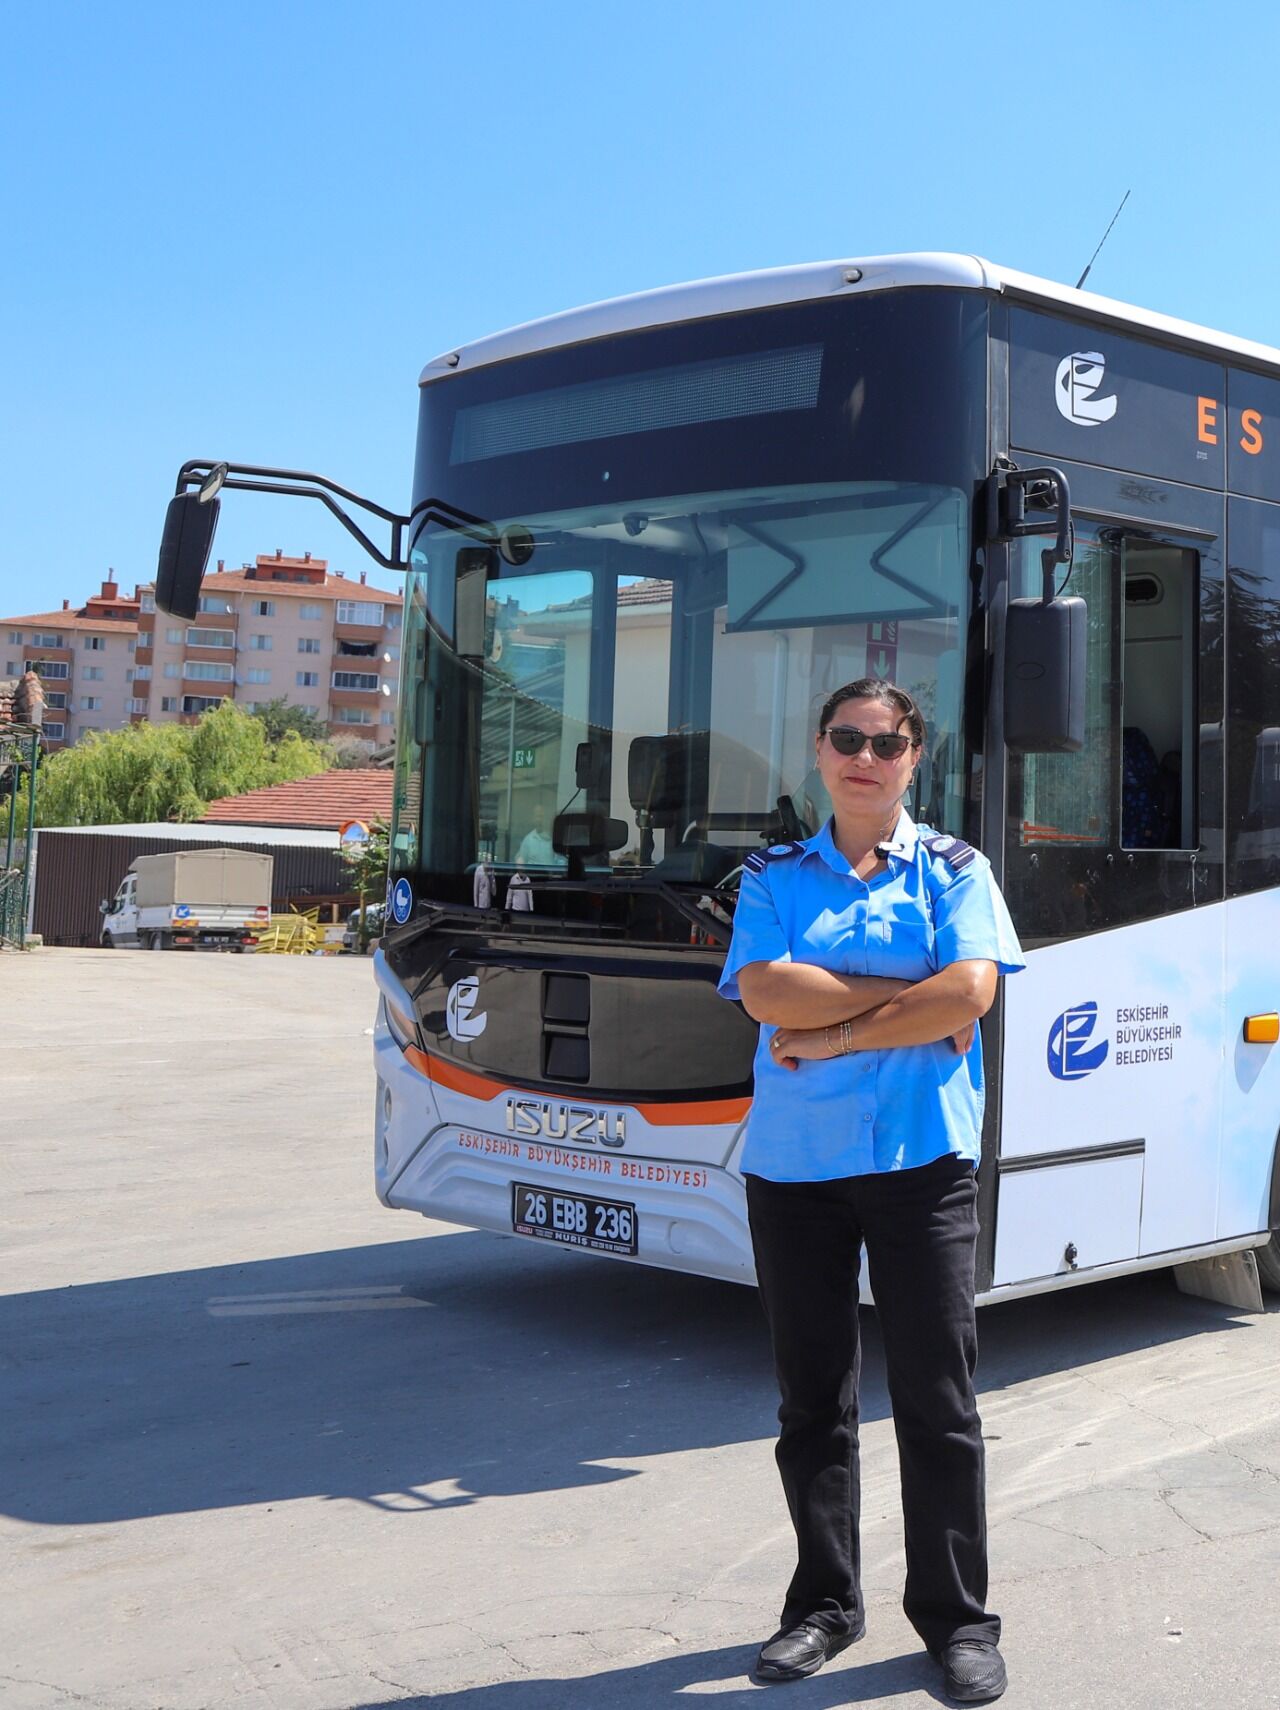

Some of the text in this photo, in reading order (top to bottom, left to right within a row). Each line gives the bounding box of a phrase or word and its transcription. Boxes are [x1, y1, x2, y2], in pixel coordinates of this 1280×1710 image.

[1116, 1003, 1169, 1023] ESKİŞEHİR
[1116, 1022, 1182, 1044] BÜYÜKŞEHİR
[1116, 1043, 1173, 1066] BELEDİYESİ
[506, 1097, 626, 1148] ISUZU
[458, 1133, 708, 1188] ESKİŞEHİR BÜYÜKŞEHİR BELEDİYESİ
[524, 1192, 632, 1241] 26 EBB 236
